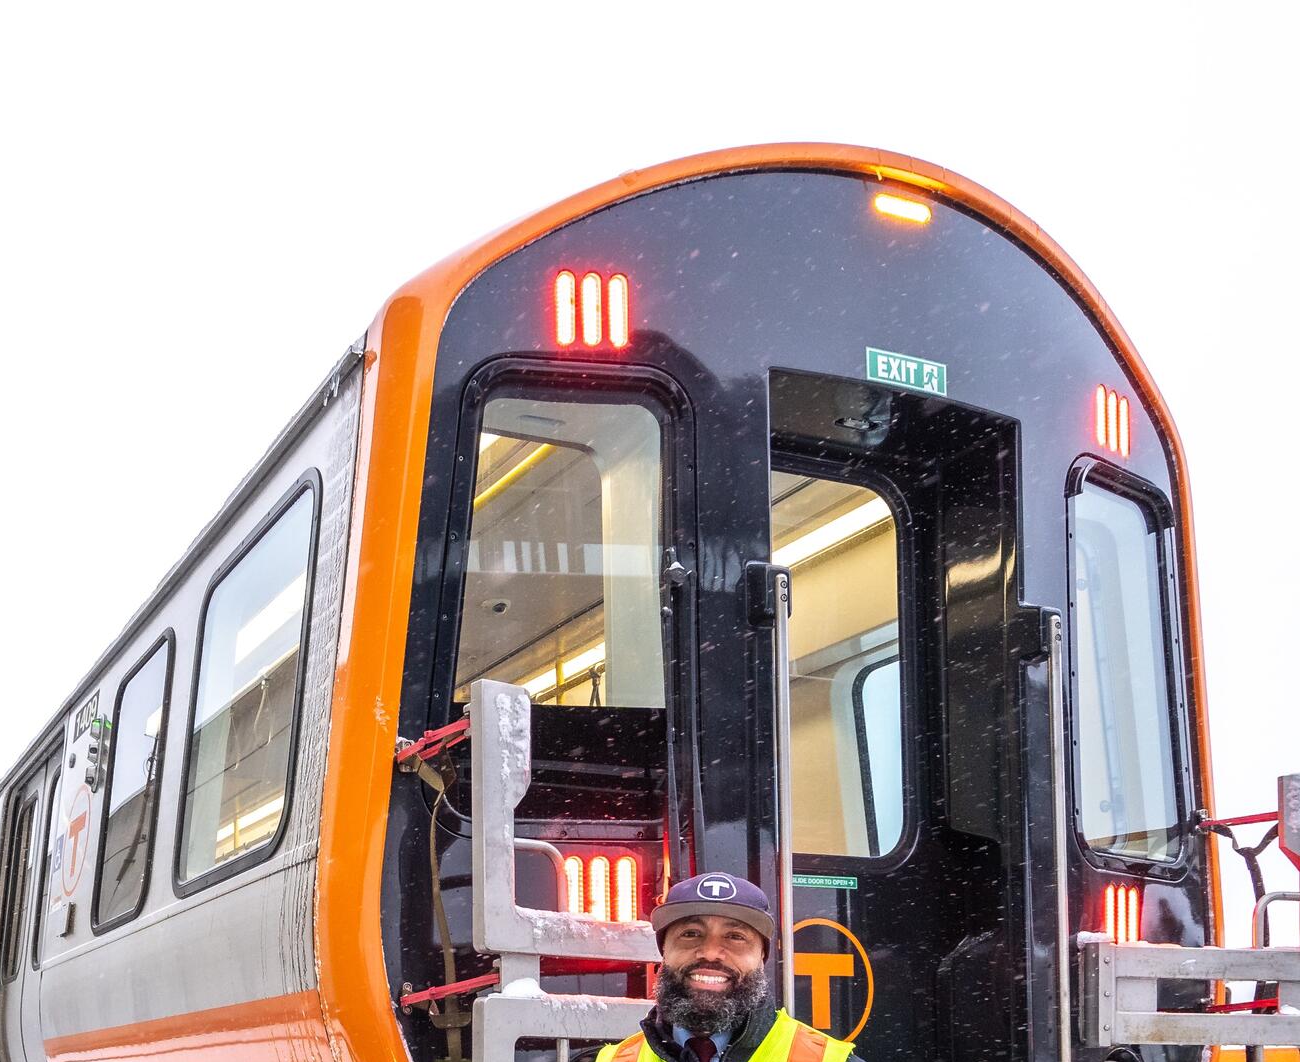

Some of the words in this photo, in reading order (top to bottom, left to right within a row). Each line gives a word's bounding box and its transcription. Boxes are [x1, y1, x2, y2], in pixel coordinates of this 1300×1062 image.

[877, 354, 917, 384] EXIT
[76, 695, 98, 737] 1409
[69, 810, 87, 878] T
[703, 881, 730, 897] T
[794, 953, 854, 1029] T
